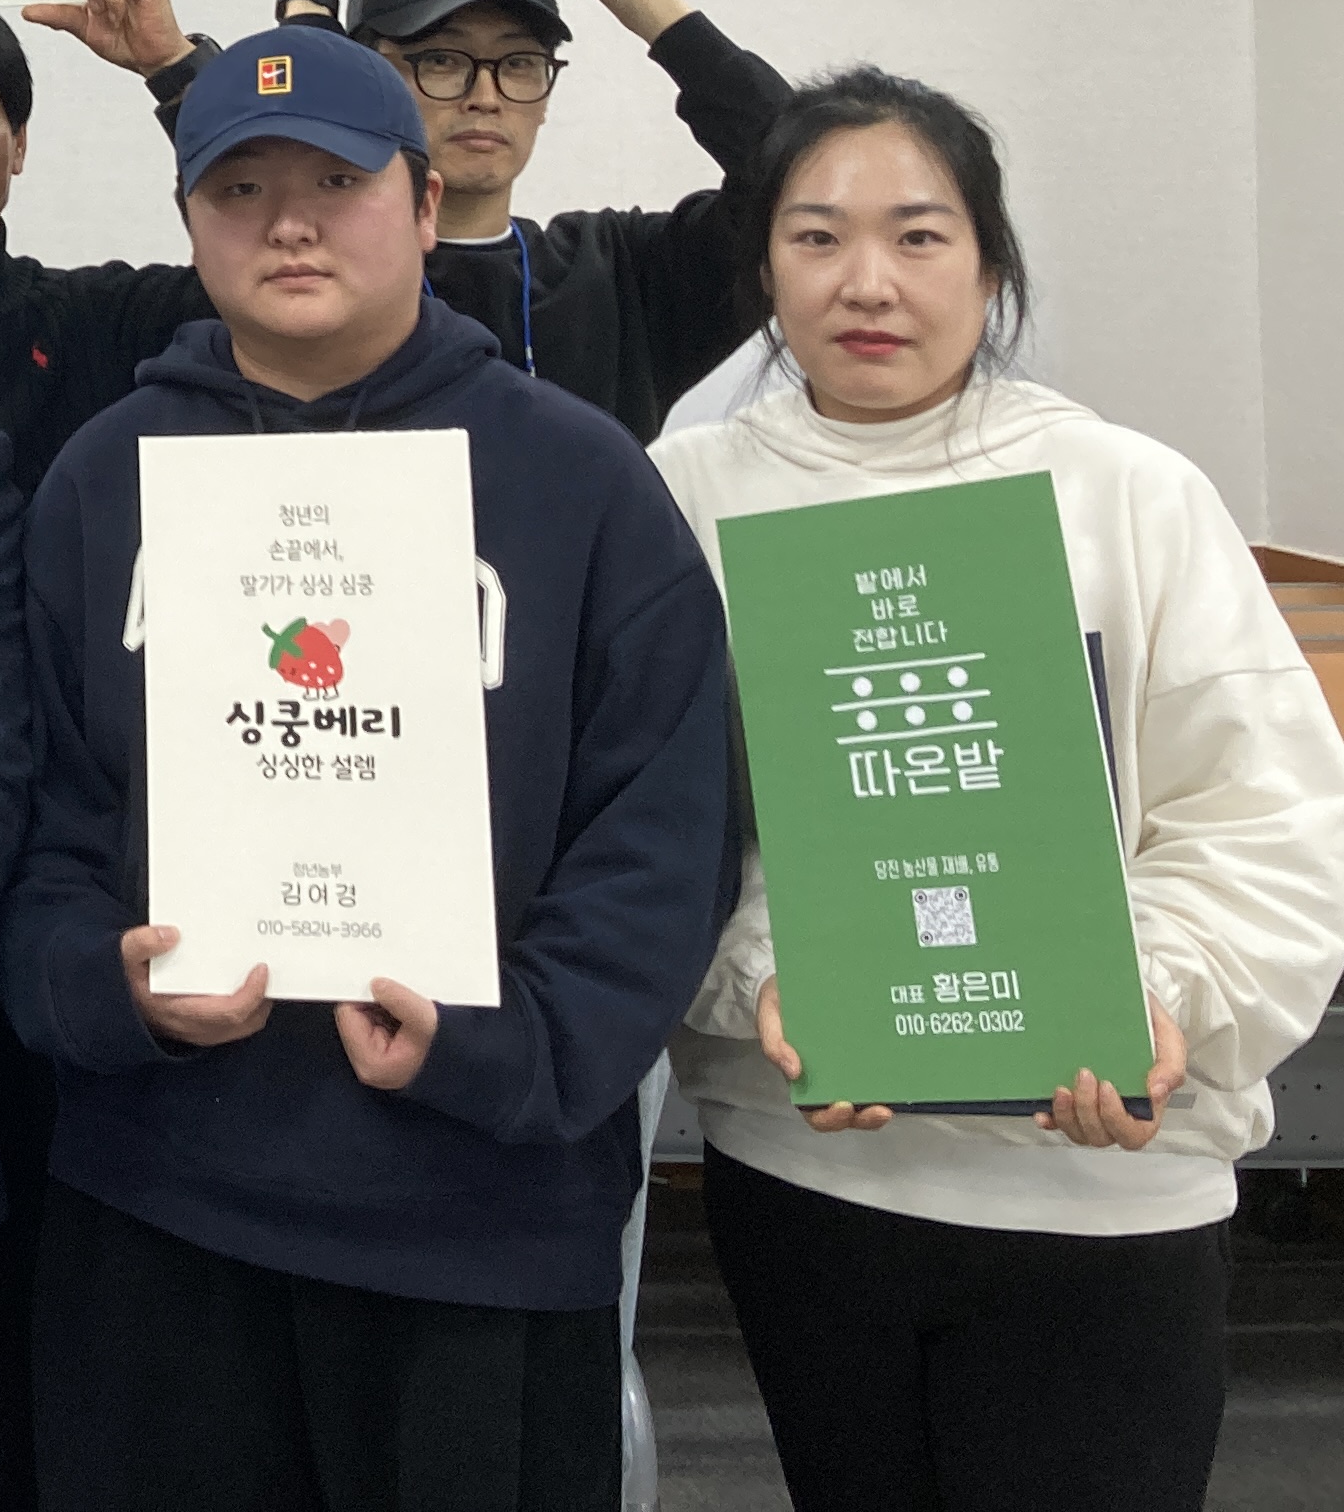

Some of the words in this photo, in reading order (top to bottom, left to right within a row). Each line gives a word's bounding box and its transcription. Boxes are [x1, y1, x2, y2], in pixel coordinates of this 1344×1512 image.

[278, 503, 330, 527] 청년의
[268, 537, 345, 563] 손끝에서,
[240, 573, 293, 597] 딸기가
[299, 573, 334, 597] 싱싱
[339, 573, 375, 597] 심쿵
[854, 564, 928, 595] 밭에서
[871, 595, 921, 620] 바로
[852, 622, 949, 653] 전합니다
[226, 700, 402, 750] 싱쿵베리
[256, 752, 325, 781] 싱싱한
[329, 753, 377, 781] 설렘
[848, 739, 1004, 799] 따온밭
[280, 880, 358, 908] 김여경
[257, 918, 382, 940] 010-5824-3966
[890, 984, 926, 1005] 대표
[932, 969, 1022, 1004] 황은미
